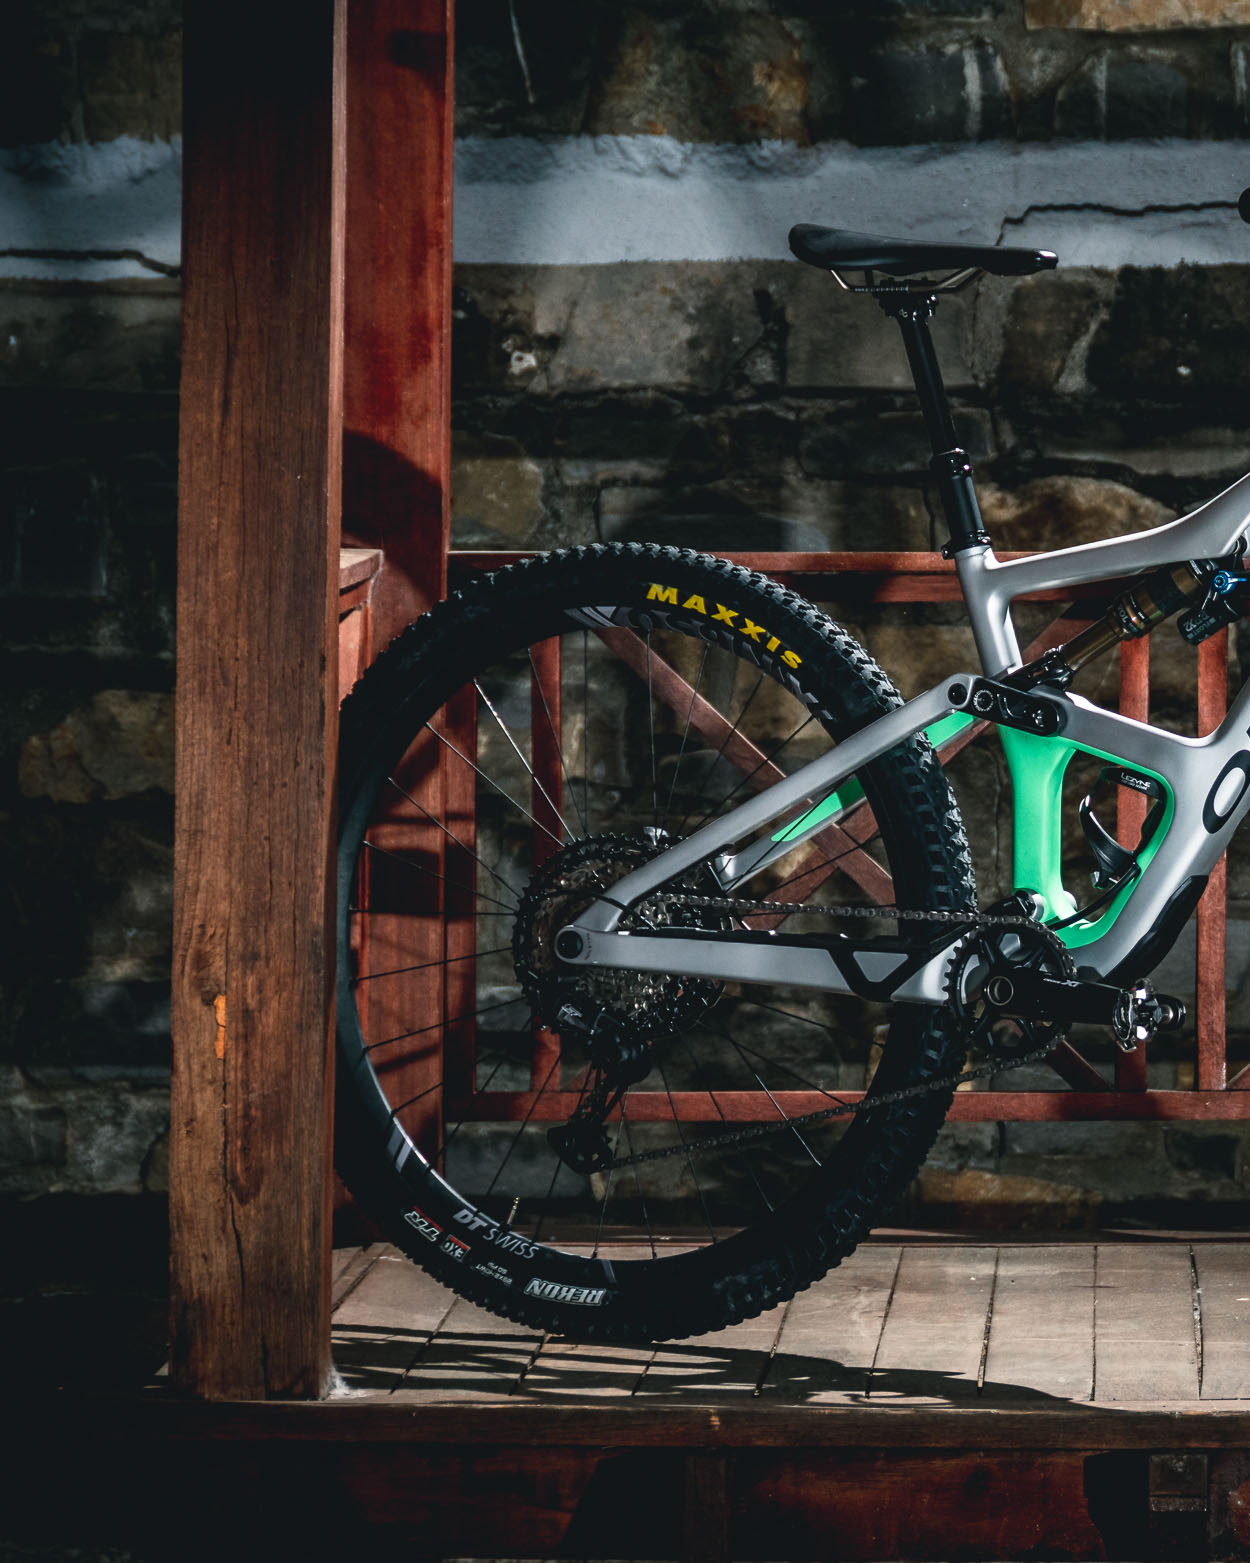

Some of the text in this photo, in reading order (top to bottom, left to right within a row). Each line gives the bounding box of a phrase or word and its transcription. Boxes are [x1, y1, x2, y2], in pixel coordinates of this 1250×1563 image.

[646, 582, 802, 669] MAXXIS
[452, 1208, 488, 1231] DT
[482, 1228, 540, 1260] SWISS
[523, 1277, 606, 1307] REKON
